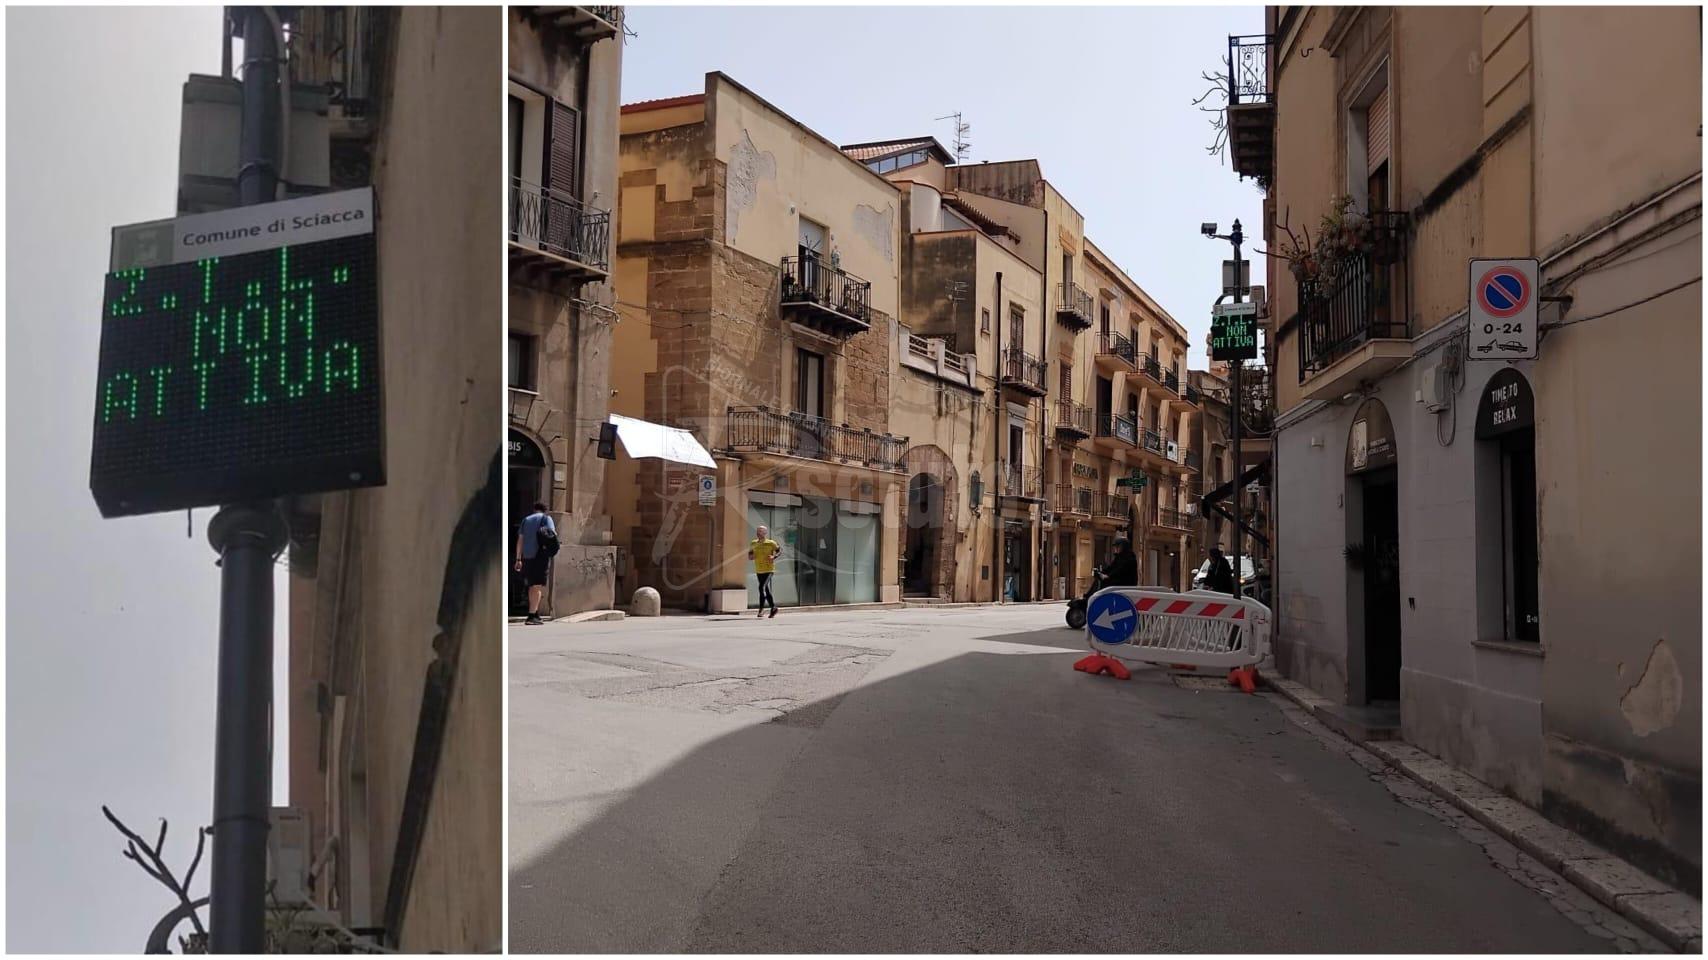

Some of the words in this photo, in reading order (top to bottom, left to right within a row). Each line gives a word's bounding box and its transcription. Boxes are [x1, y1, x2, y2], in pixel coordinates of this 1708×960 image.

[183, 225, 262, 247] Comune
[267, 219, 285, 234] di
[292, 209, 365, 230] Sciacca
[194, 294, 314, 357] NON
[1226, 324, 1247, 337] NON
[1213, 335, 1254, 349] ATTIVA
[103, 342, 358, 422] ATTIVA
[1491, 386, 1507, 404] TIME
[1509, 382, 1518, 398] TO
[1493, 405, 1517, 425] RELAX
